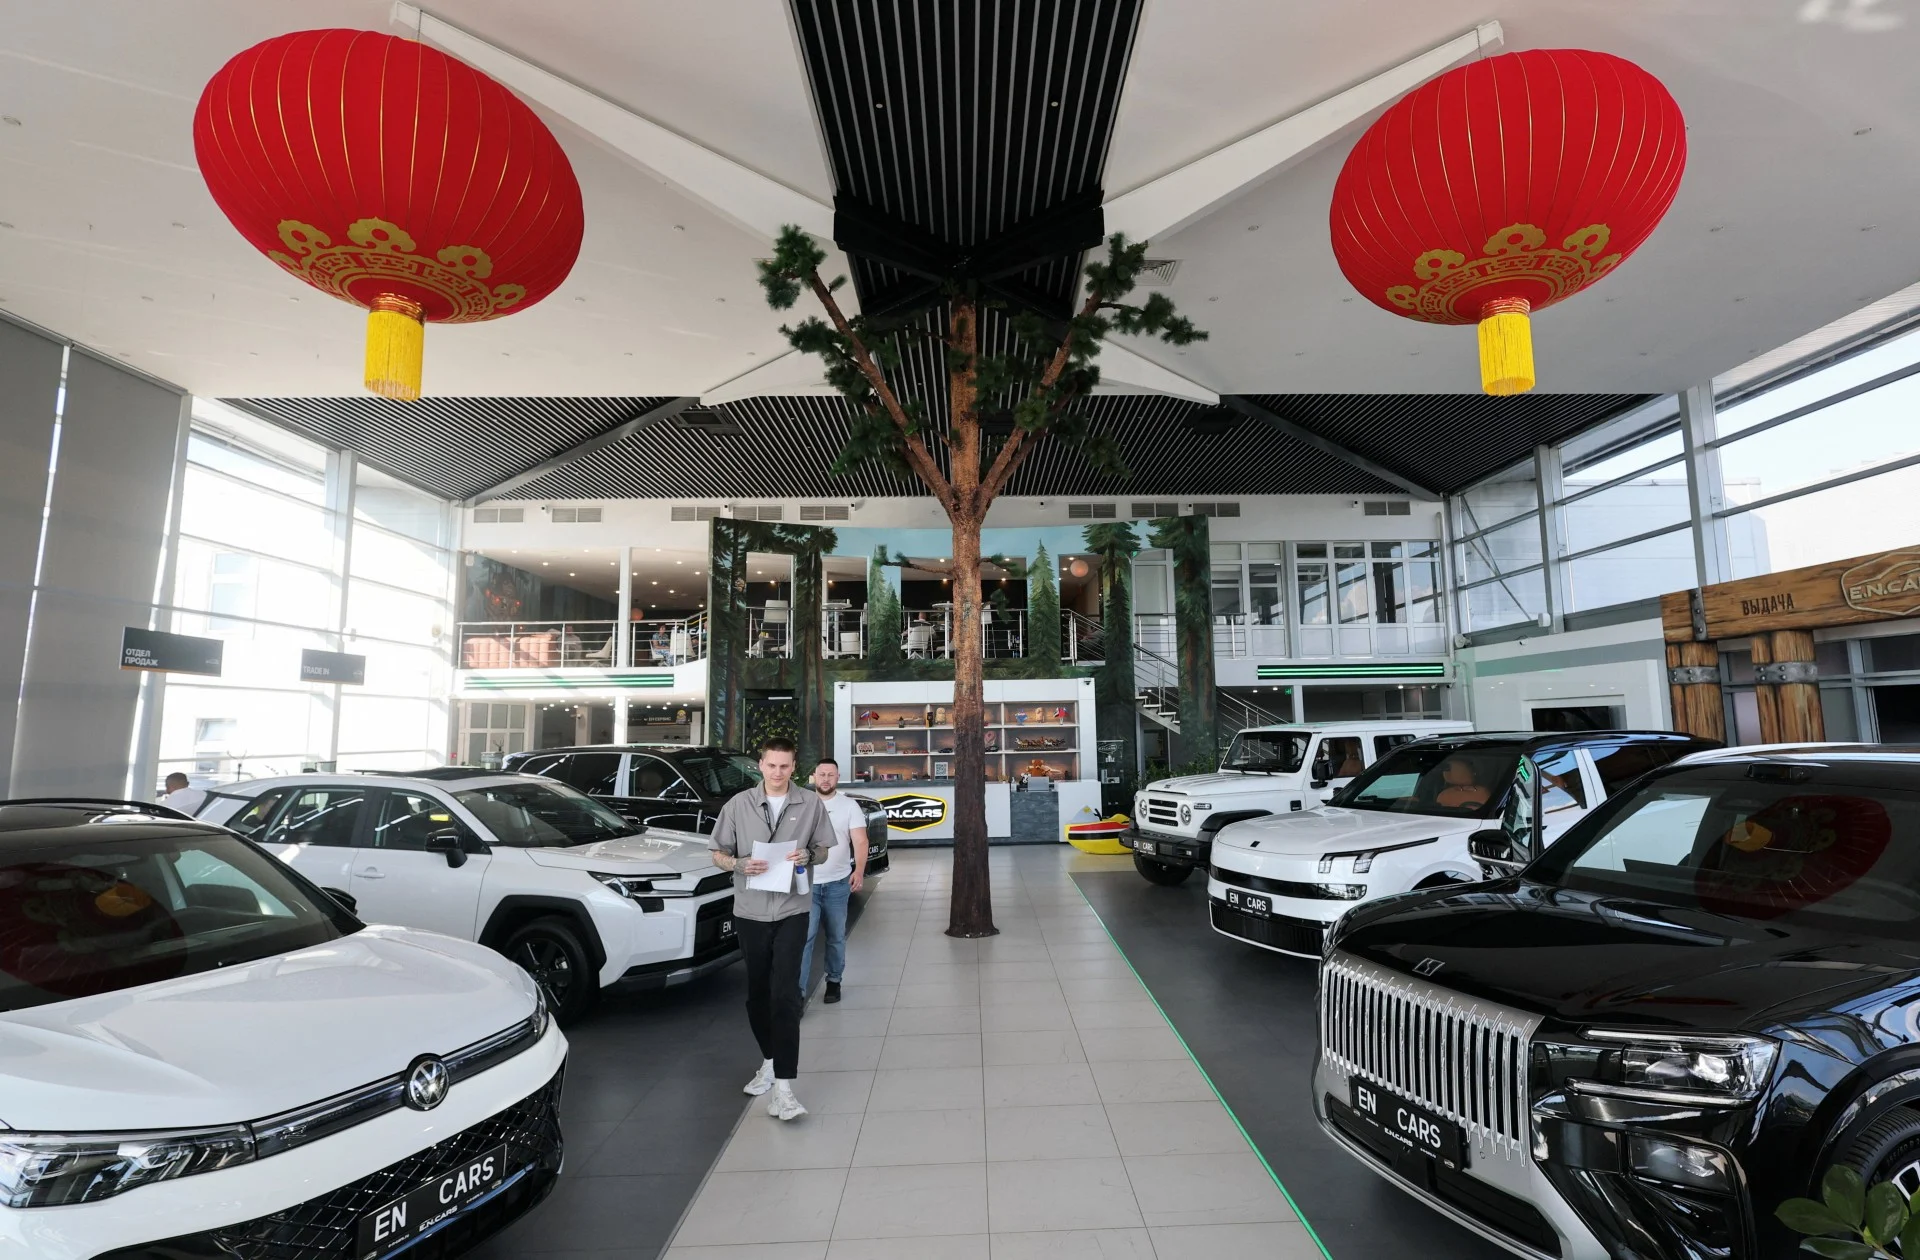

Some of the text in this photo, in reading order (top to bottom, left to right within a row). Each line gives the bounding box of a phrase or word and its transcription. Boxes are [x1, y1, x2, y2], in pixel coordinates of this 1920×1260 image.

[1742, 593, 1794, 616] ВЫДАЧА
[125, 648, 151, 657] ОТДЕЛ
[124, 656, 158, 666] ПРОДАЖ
[303, 665, 323, 675] TRADE
[886, 808, 942, 818] .N.CARS
[1230, 892, 1239, 904] EN
[1246, 897, 1267, 911] CARS
[723, 920, 731, 932] EN
[1358, 1086, 1441, 1148] EN CARS
[374, 1156, 495, 1242] EN CARS
[418, 1205, 458, 1232] E.N.CARS
